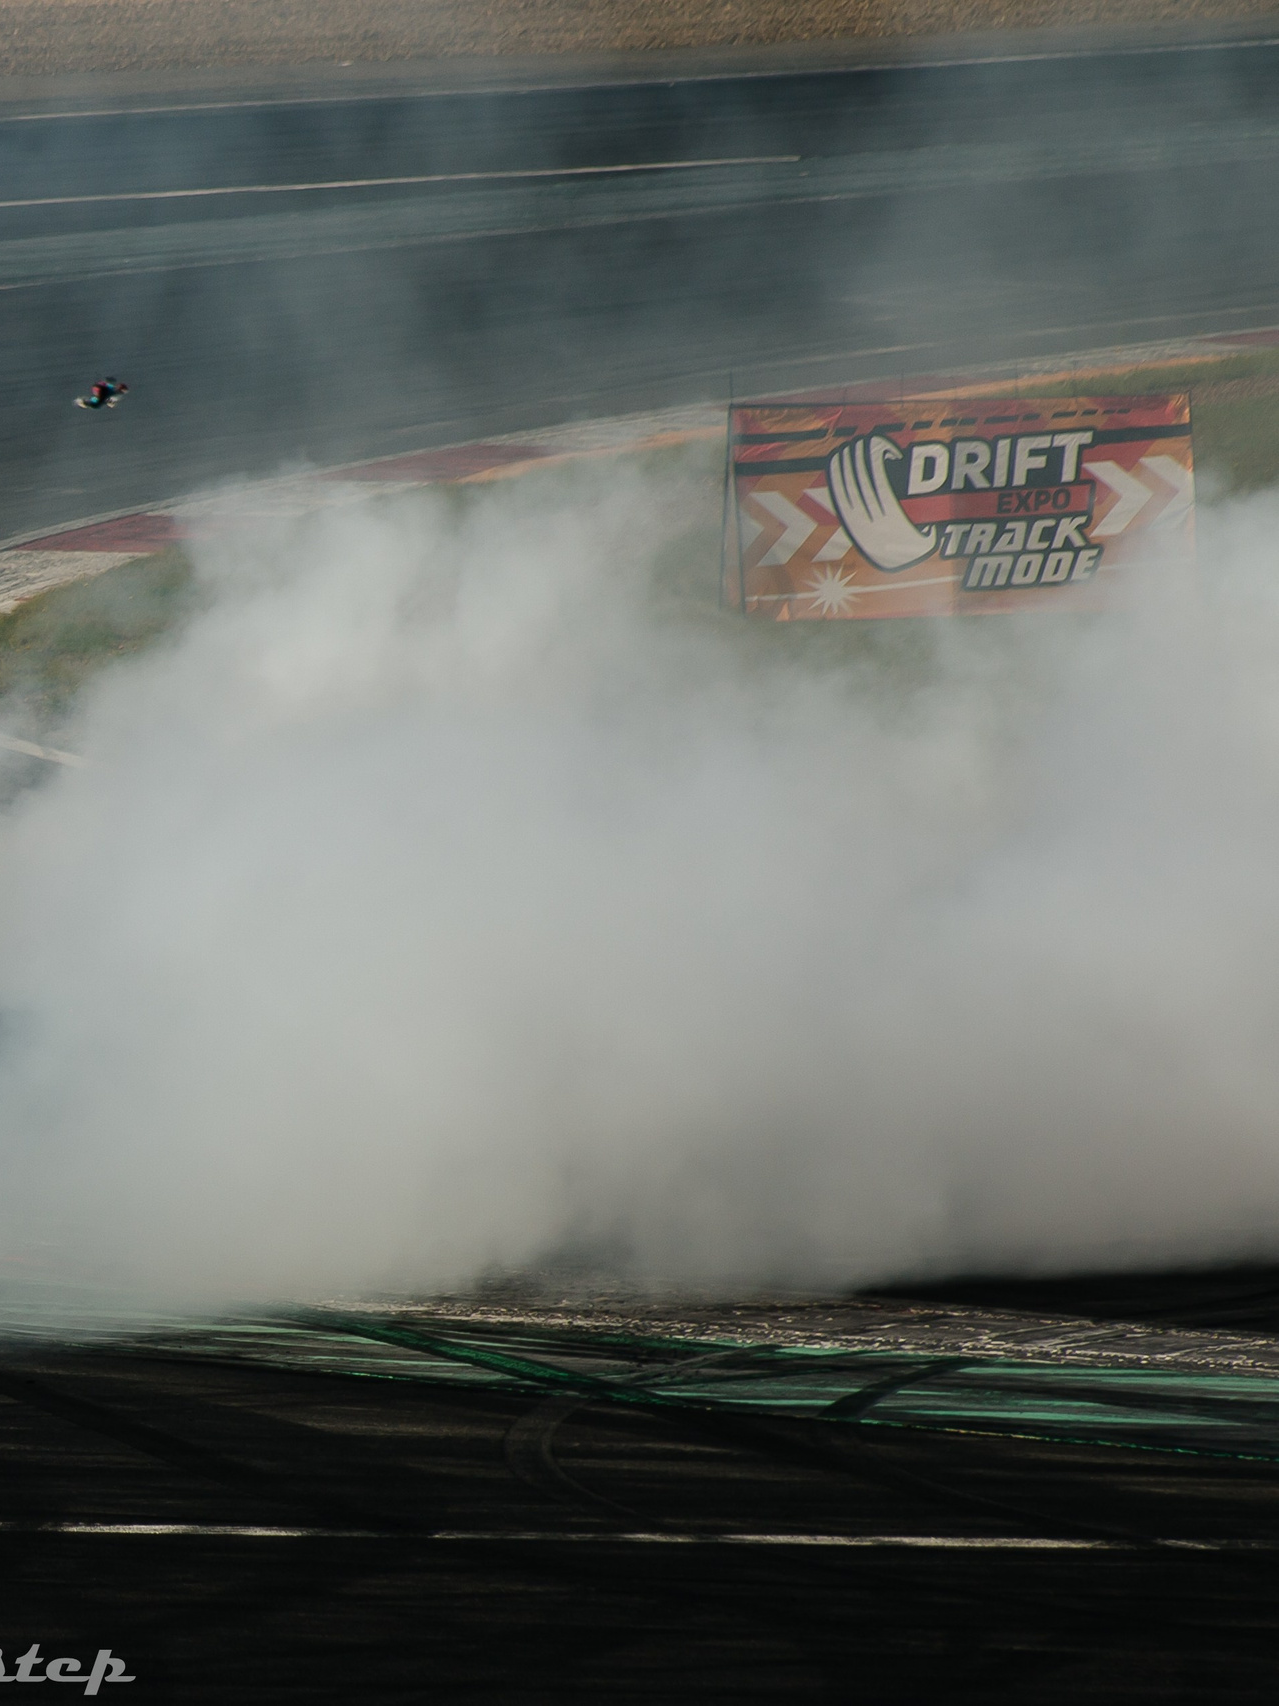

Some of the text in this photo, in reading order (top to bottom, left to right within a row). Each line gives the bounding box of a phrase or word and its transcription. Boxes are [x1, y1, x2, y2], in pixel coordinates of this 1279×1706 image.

[907, 430, 1094, 495] DRIFT
[996, 488, 1071, 515] EXPO
[943, 515, 1090, 556] TRACK
[965, 547, 1101, 588] MODE
